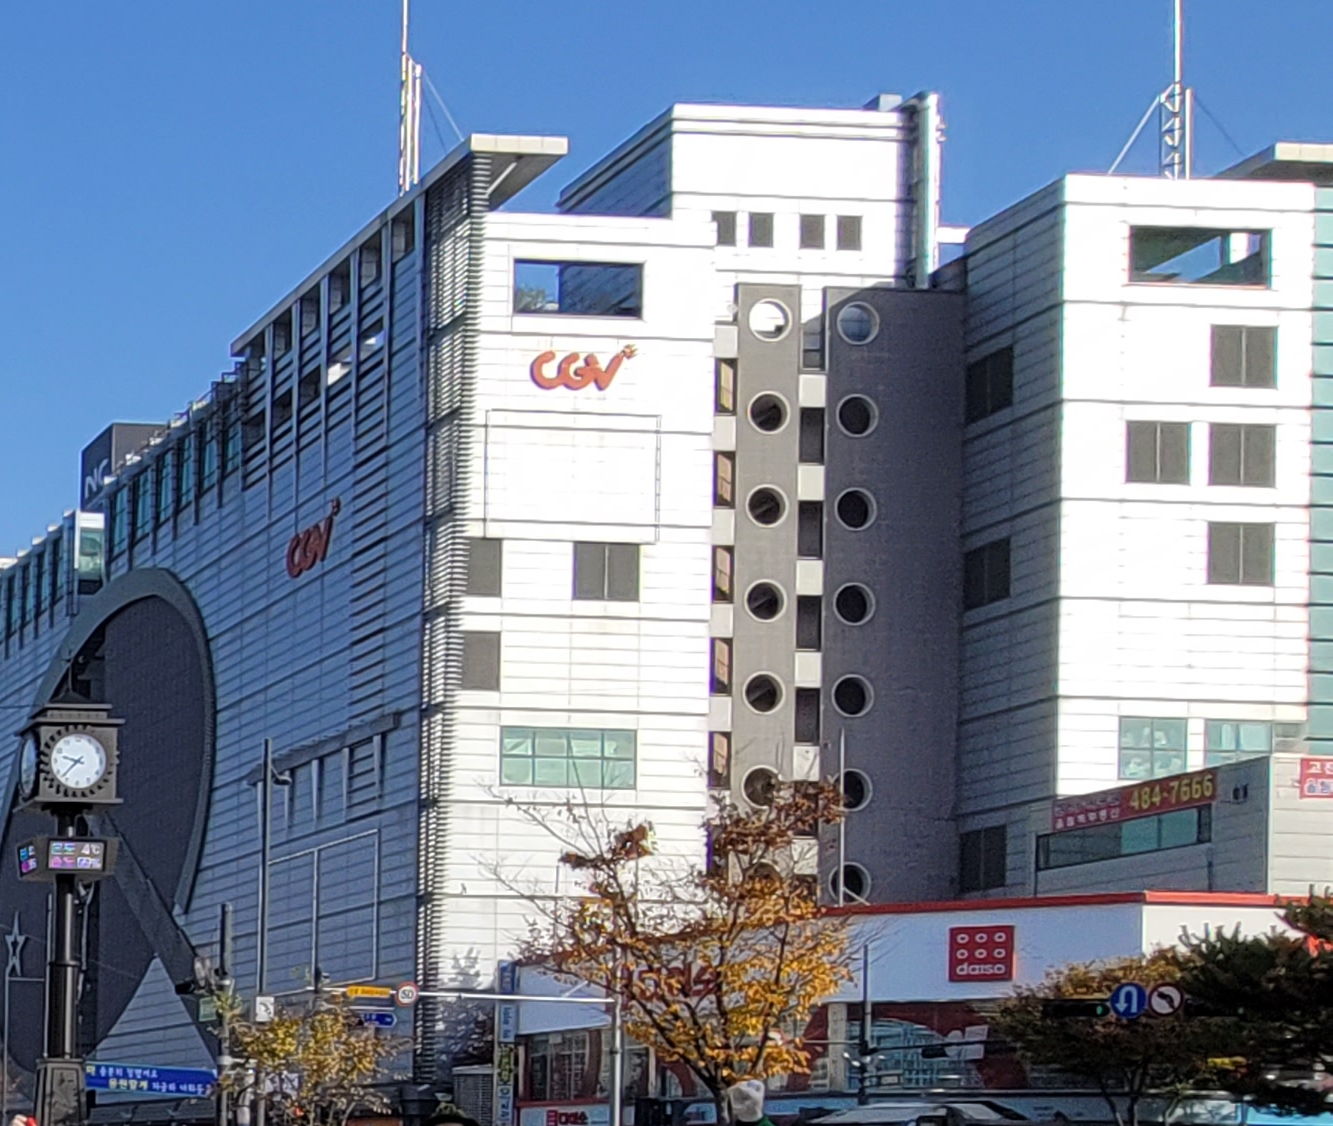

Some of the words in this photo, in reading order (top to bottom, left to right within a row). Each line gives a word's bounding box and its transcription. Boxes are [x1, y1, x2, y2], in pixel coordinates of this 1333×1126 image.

[530, 348, 627, 391] CGV
[286, 503, 336, 578] CGV
[1129, 774, 1214, 811] 484-7666
[956, 961, 1006, 977] daiso
